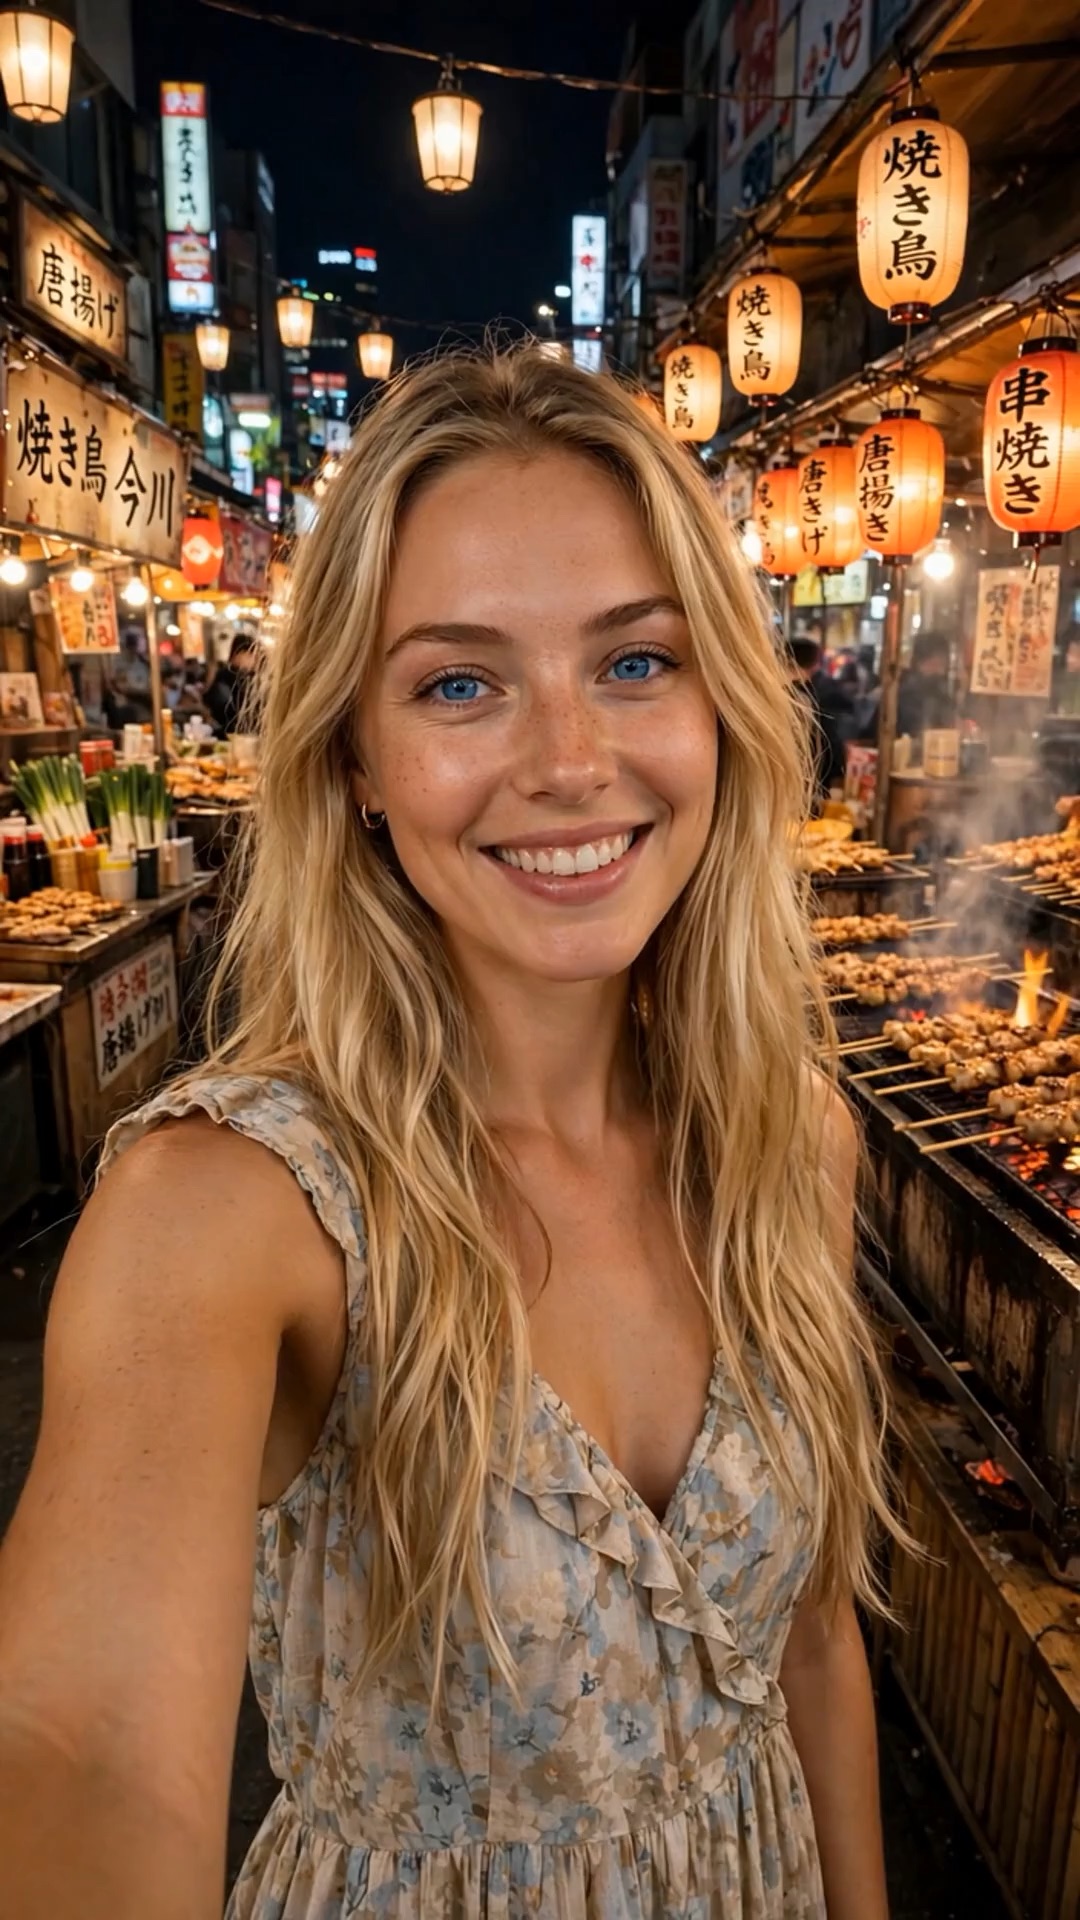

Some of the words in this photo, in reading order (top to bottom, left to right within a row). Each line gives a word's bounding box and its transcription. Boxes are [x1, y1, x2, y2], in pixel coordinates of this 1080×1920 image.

[884, 130, 942, 280] 焼き鳥
[38, 243, 119, 338] 唐揚げ
[736, 285, 771, 380] 焼き鳥
[670, 355, 694, 429] 焼き鳥
[996, 367, 1050, 514] 串焼き
[16, 399, 175, 537] 焼き鳥今川
[799, 459, 828, 555] 唐きげ
[858, 433, 895, 541] 唐揚き
